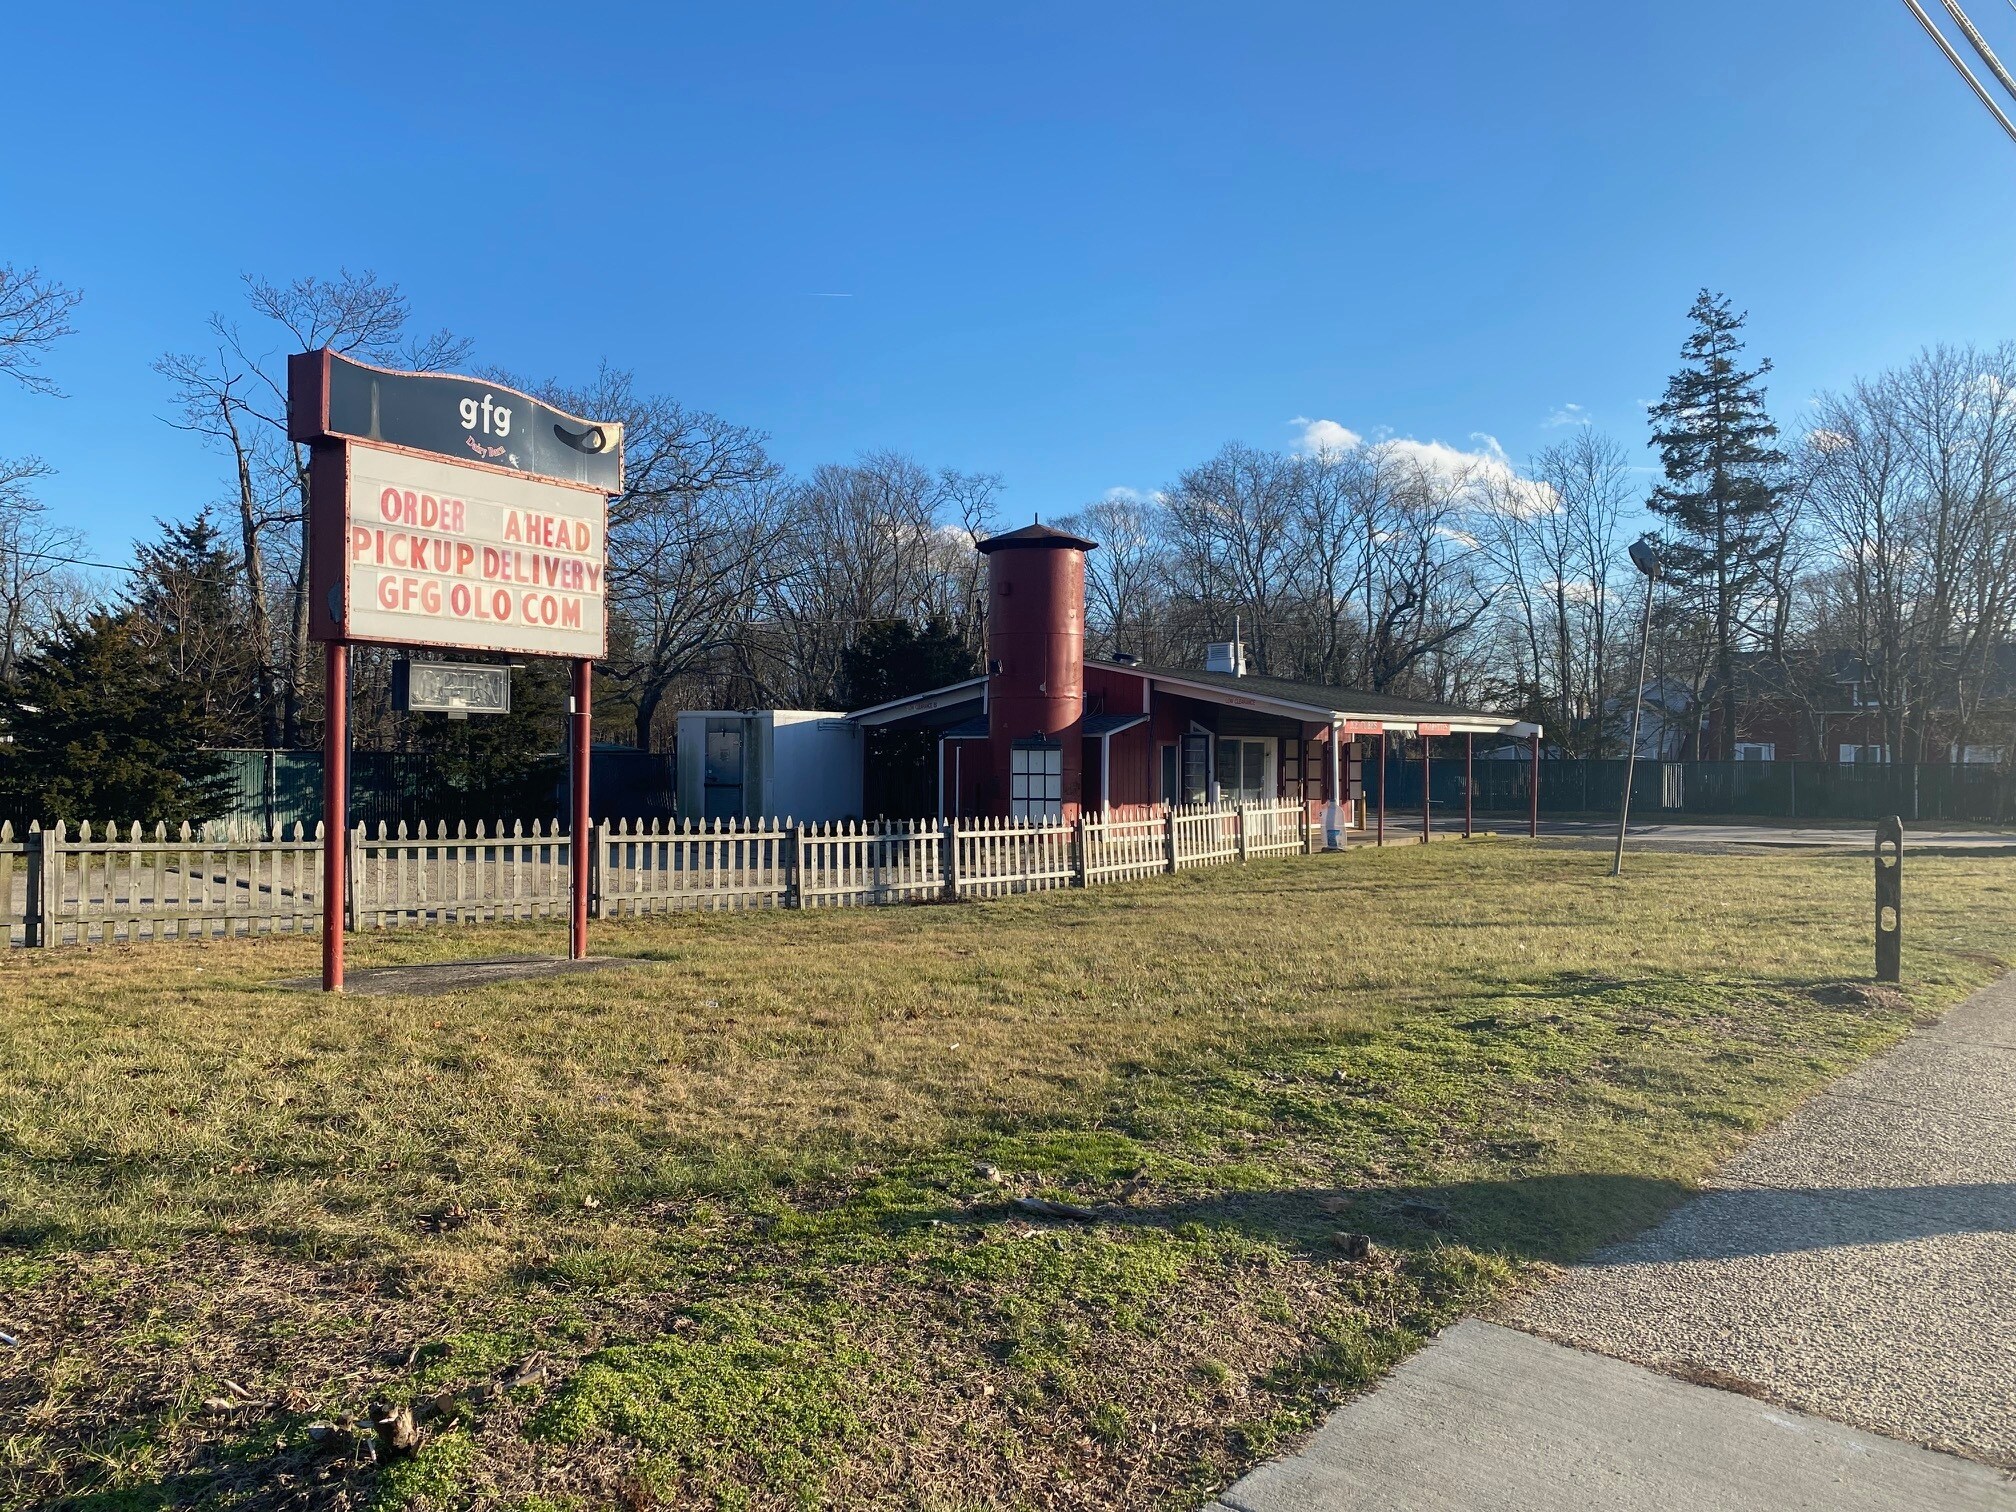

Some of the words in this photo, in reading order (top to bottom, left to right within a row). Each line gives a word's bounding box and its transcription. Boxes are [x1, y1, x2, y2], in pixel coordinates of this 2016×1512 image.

[460, 394, 512, 437] gfg
[466, 435, 487, 458] Dairy
[381, 487, 465, 533] ORDER
[504, 510, 591, 552] AHEAD
[353, 526, 474, 575] PICKUP
[483, 546, 602, 592] DELIVERY
[378, 575, 441, 614] GFG
[451, 583, 511, 621] OLO
[522, 593, 581, 628] COM
[417, 669, 500, 704] OPEN
